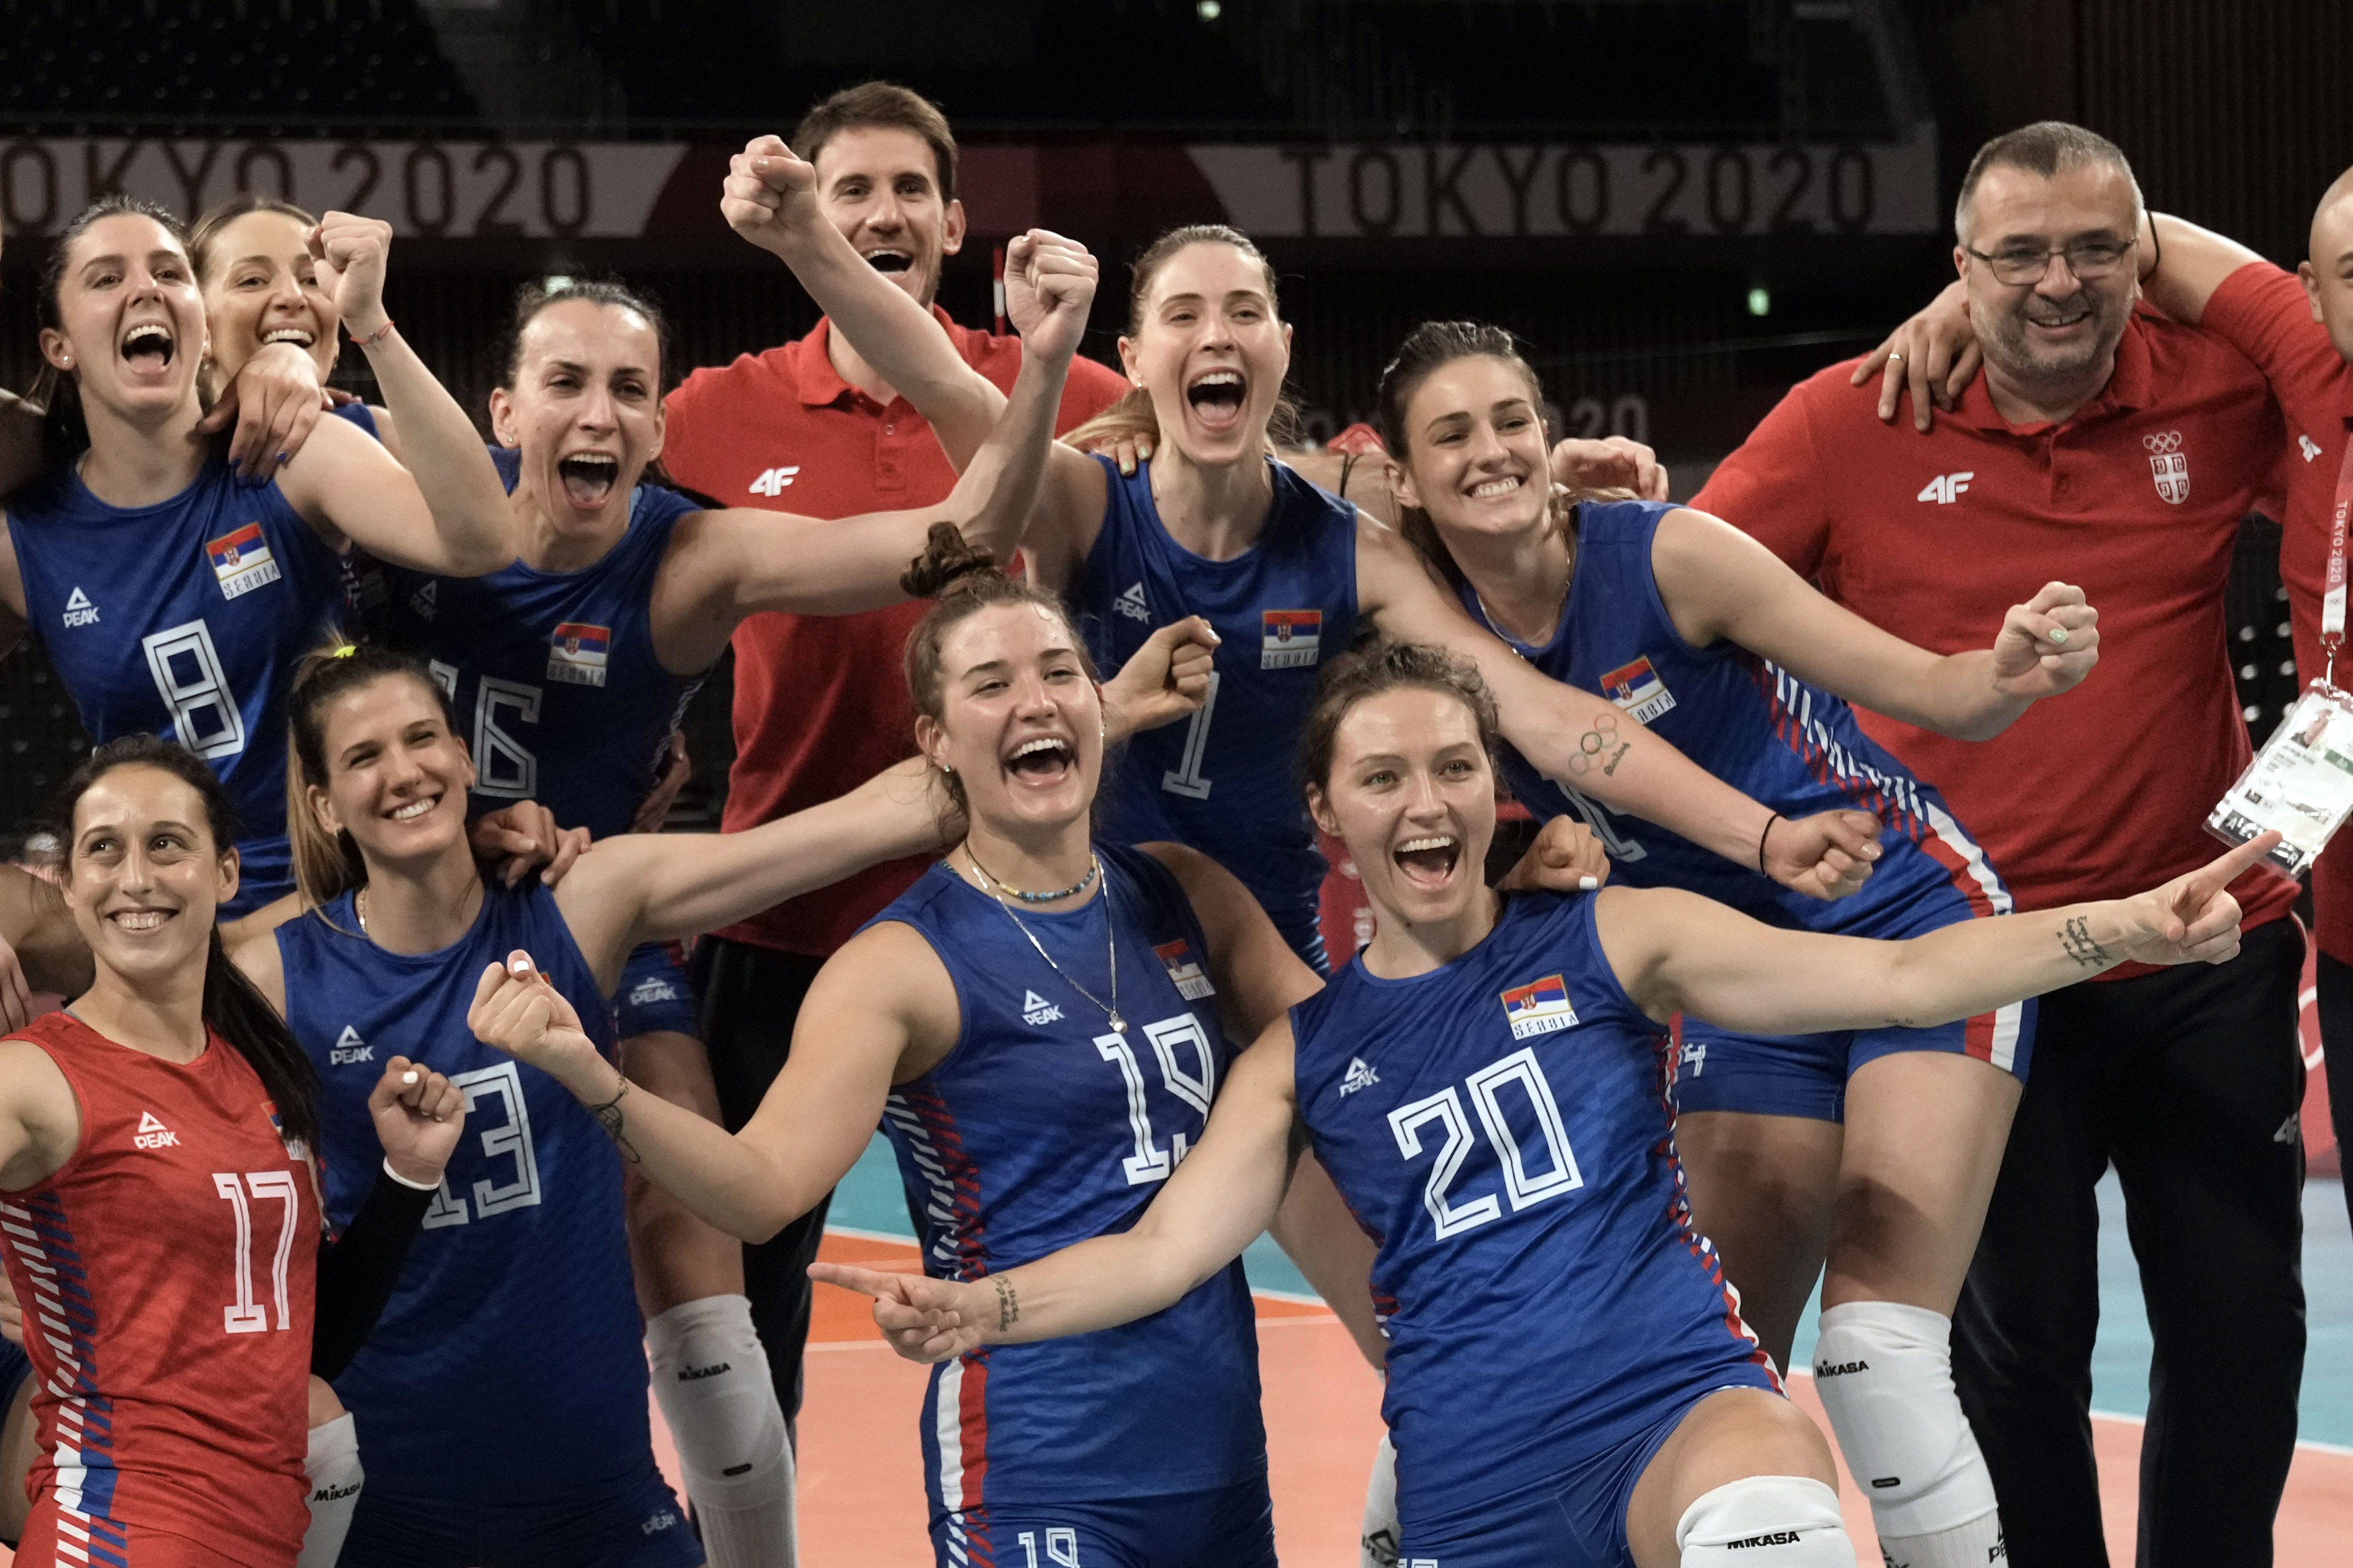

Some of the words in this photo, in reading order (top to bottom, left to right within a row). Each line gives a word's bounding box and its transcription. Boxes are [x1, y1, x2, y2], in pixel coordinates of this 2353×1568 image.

[2, 143, 296, 237] OKYO
[328, 146, 591, 238] 2020
[1281, 148, 1609, 238] TOKYO
[1639, 147, 1875, 236] 2020
[749, 466, 800, 496] 4F
[1917, 471, 1974, 504] 4F
[2333, 499, 2347, 546] TOKYO
[223, 563, 278, 598] SERBIA
[2330, 548, 2343, 582] 2020
[63, 607, 100, 628] PEAK
[1113, 597, 1149, 625] PEAK
[142, 619, 244, 759] 8
[1631, 692, 1674, 723] RBIA
[629, 984, 679, 1006] PEAK
[1022, 1004, 1065, 1026] PEAK
[1514, 1014, 1578, 1037] SERBIA
[330, 1045, 374, 1065] PEAK
[1339, 1066, 1380, 1098] PEAK
[1092, 1013, 1215, 1185] 19
[134, 1131, 182, 1150] PEAK
[1387, 1046, 1584, 1241] 20
[212, 1170, 298, 1333] 17
